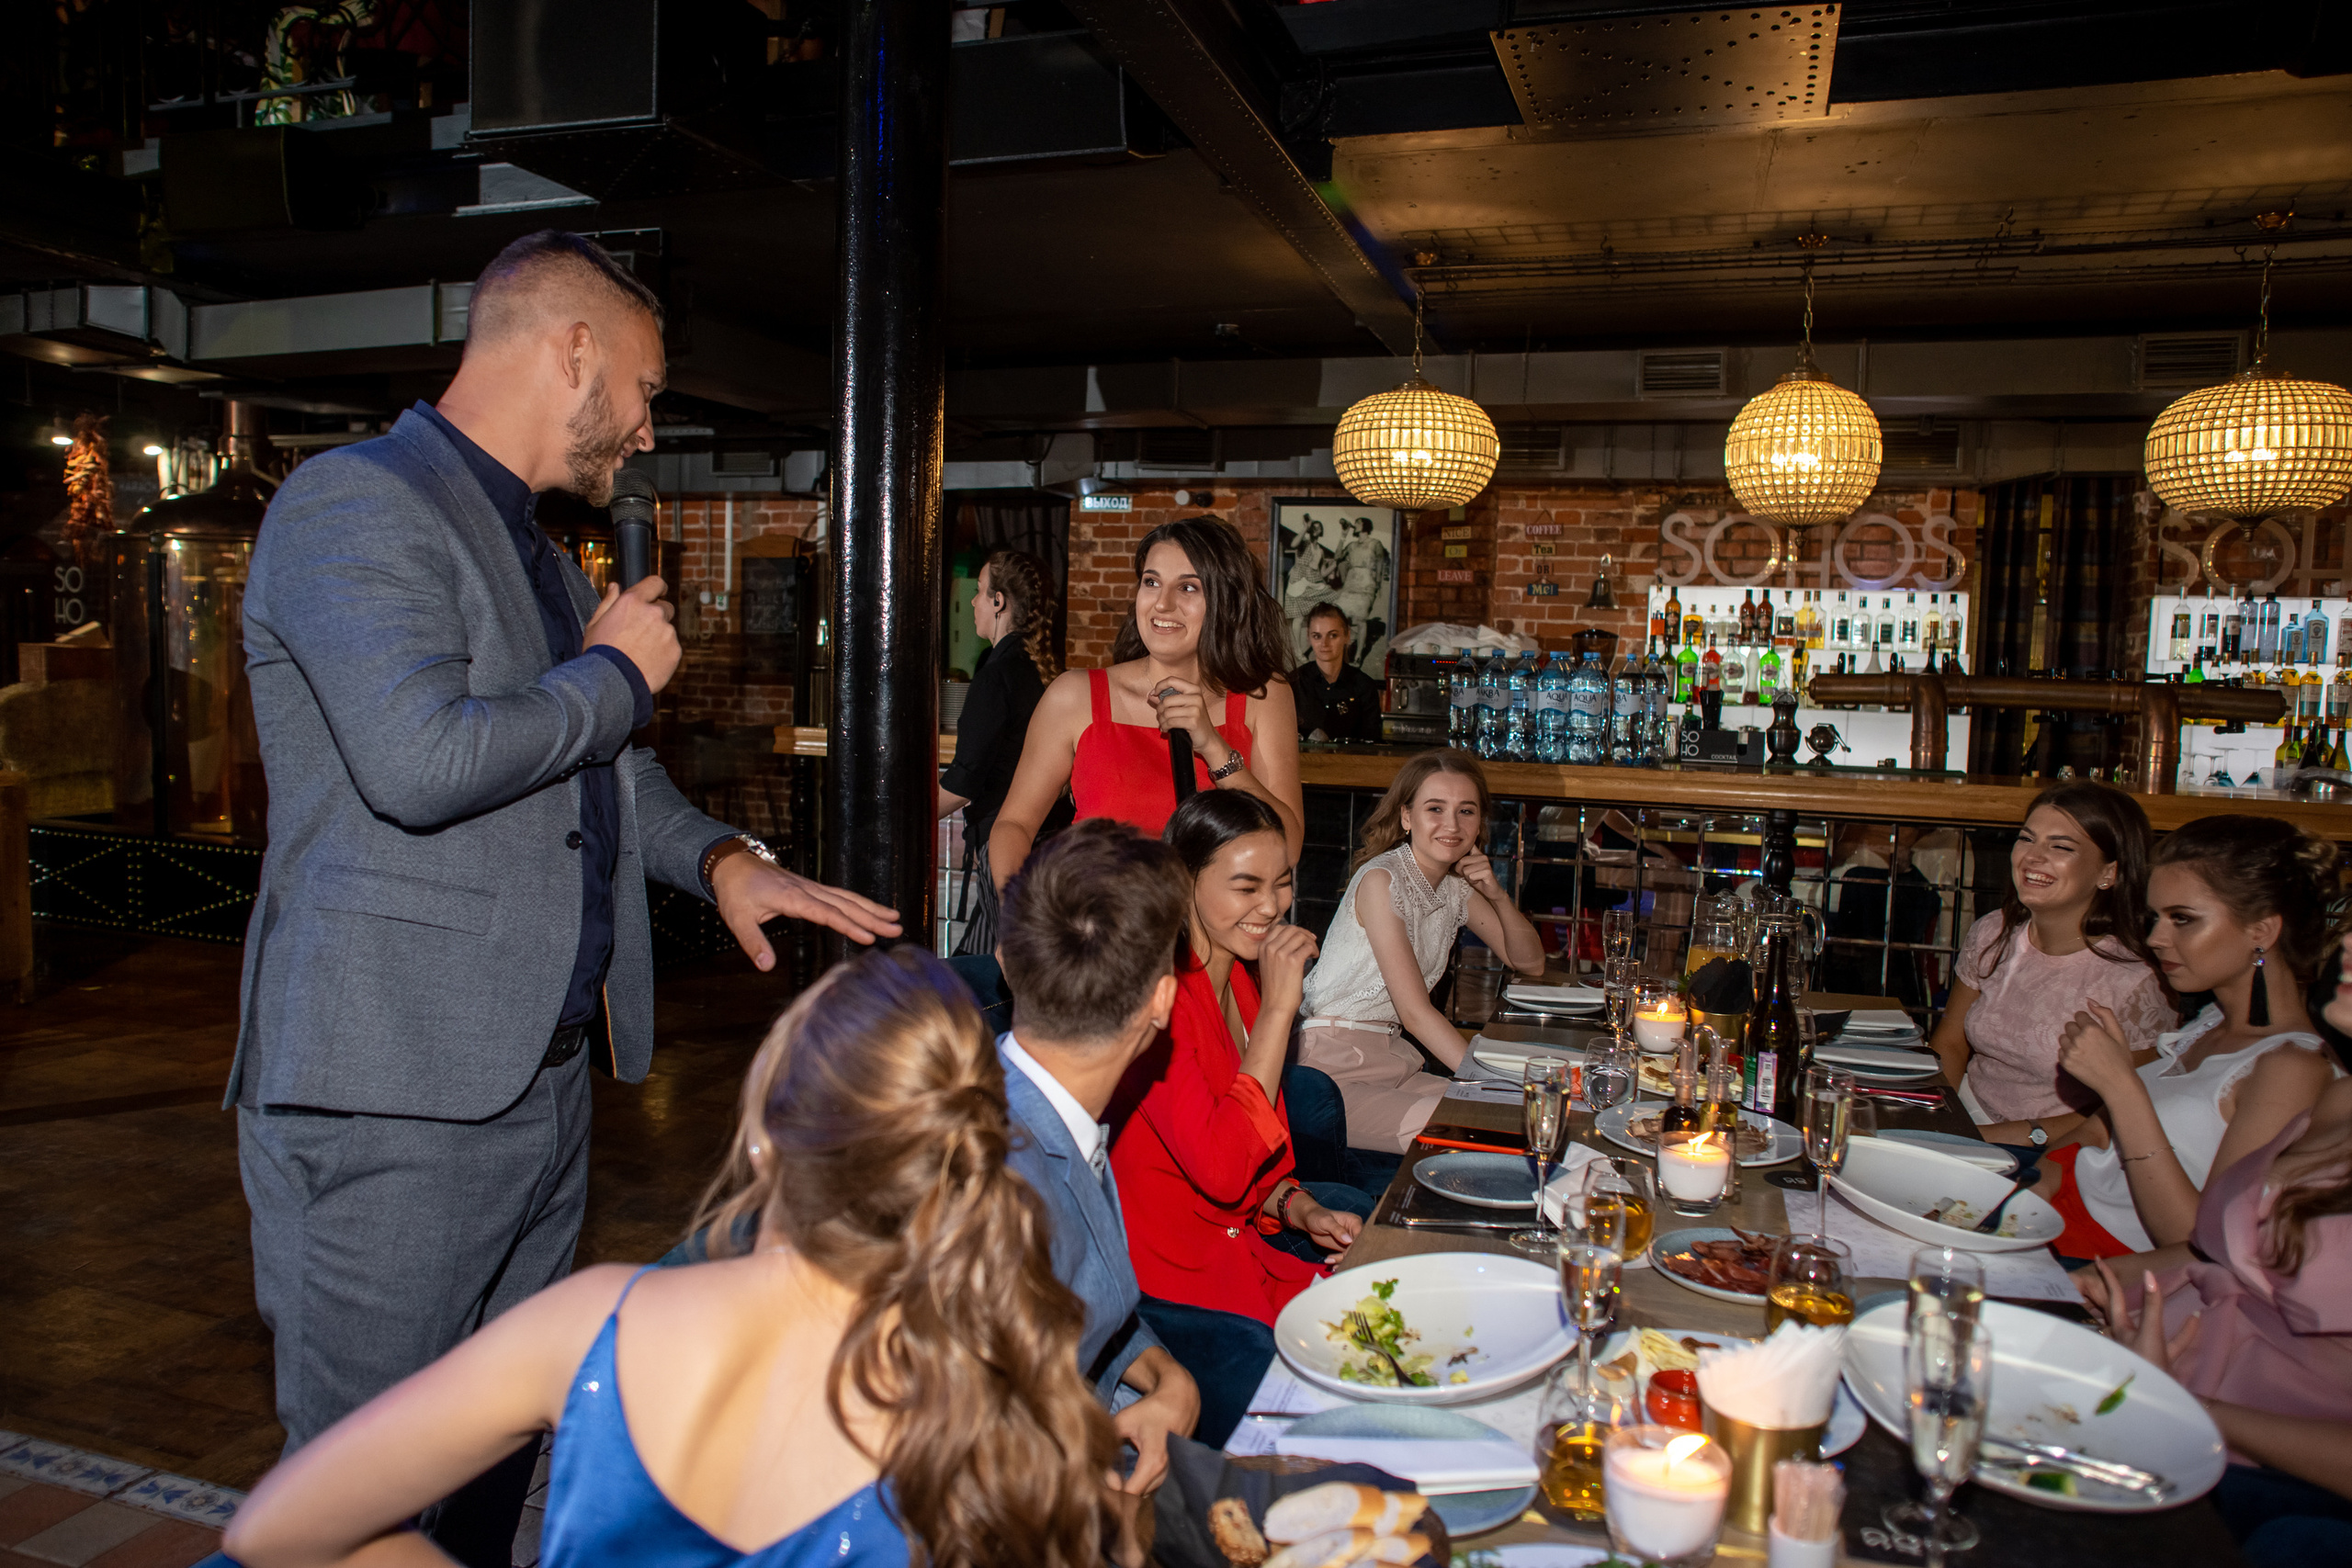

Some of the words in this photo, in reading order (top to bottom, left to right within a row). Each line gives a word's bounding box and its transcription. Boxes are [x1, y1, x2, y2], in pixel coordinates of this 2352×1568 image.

[1084, 496, 1128, 509] ВЫХОД
[1443, 527, 1470, 538] NICE
[1526, 525, 1562, 535] COFFEE
[1533, 544, 1553, 554] Tea
[1655, 513, 1966, 591] SOHOS
[53, 566, 83, 592] SO
[1438, 570, 1472, 581] LEAVE
[54, 598, 84, 625] HO
[1545, 692, 1568, 703] AQUA
[1574, 694, 1597, 705] AQUA
[1681, 730, 1700, 743] SO
[1680, 744, 1699, 756] HO
